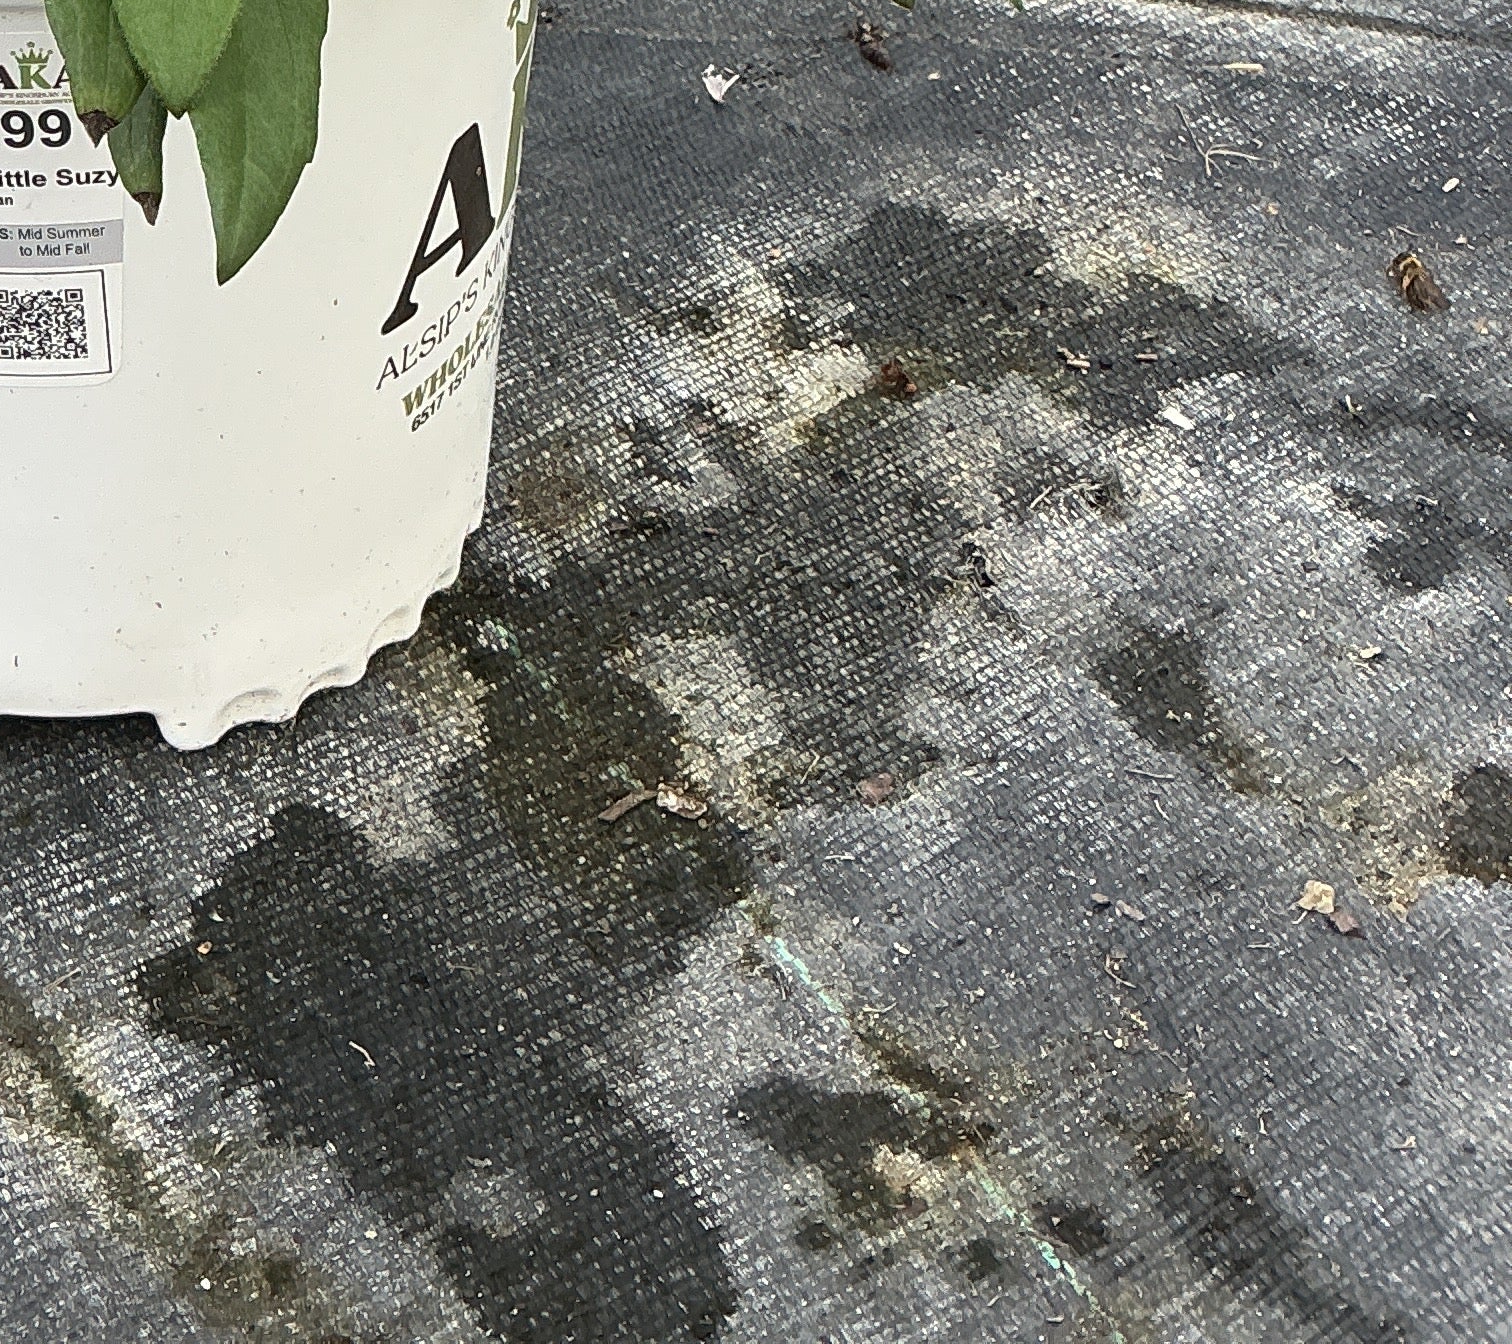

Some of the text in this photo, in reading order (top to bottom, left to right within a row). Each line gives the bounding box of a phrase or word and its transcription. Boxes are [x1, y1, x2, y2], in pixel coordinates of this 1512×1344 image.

[56, 168, 119, 188] Suzy
[18, 227, 43, 241] Mid
[46, 225, 106, 240] Summer
[19, 242, 91, 257] to Mid Fall
[375, 277, 479, 391] ALSIP'S
[400, 300, 495, 417] WHOLE
[411, 392, 445, 433] 6517
